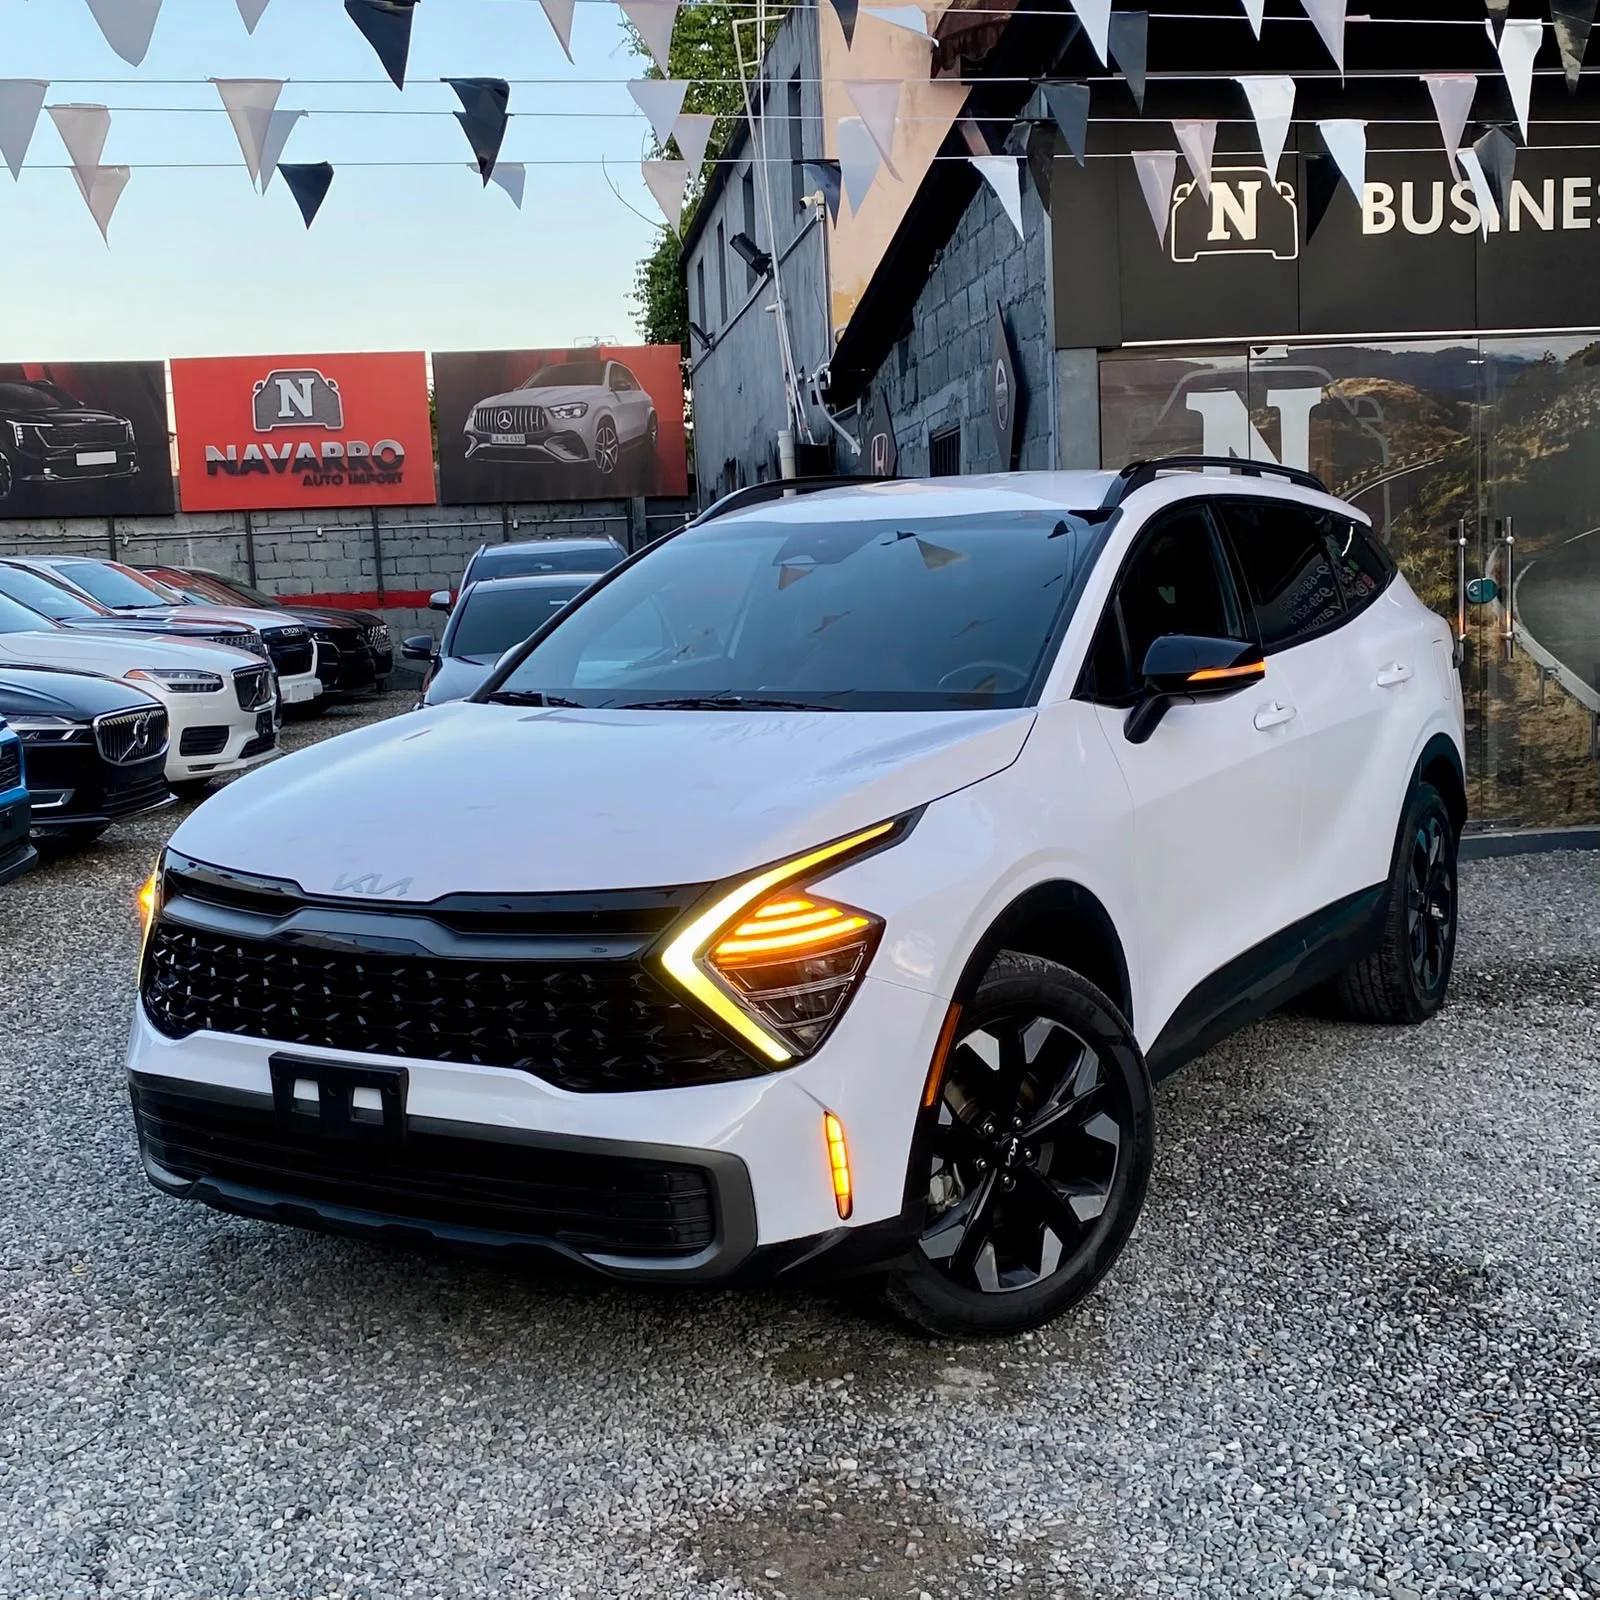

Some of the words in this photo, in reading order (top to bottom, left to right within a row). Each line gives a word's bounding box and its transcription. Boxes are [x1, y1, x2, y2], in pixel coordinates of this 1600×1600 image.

[1207, 180, 1262, 241] N
[1361, 176, 1600, 235] BUSNE
[275, 377, 315, 418] N
[205, 438, 405, 476] NAVARRO
[303, 473, 344, 487] AUTO
[348, 471, 404, 486] IMPORT
